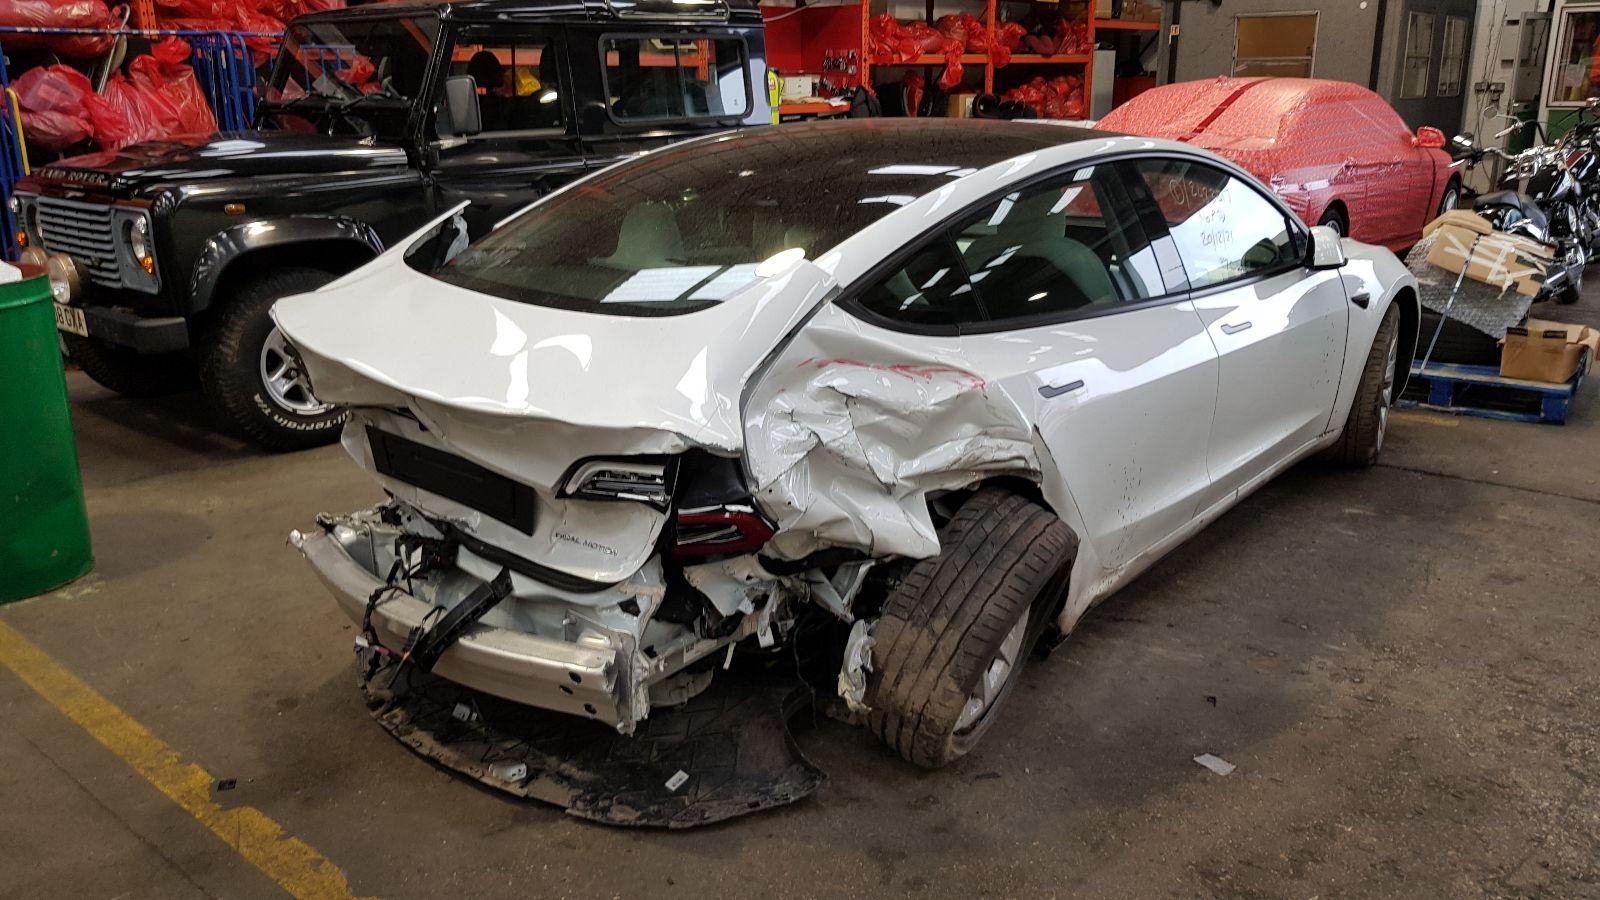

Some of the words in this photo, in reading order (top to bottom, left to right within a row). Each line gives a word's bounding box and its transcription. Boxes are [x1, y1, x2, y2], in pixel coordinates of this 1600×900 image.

[41, 168, 66, 179] LAND
[67, 171, 105, 184] ROVER
[555, 531, 581, 544] DUAL
[582, 539, 618, 556] MOTOR
